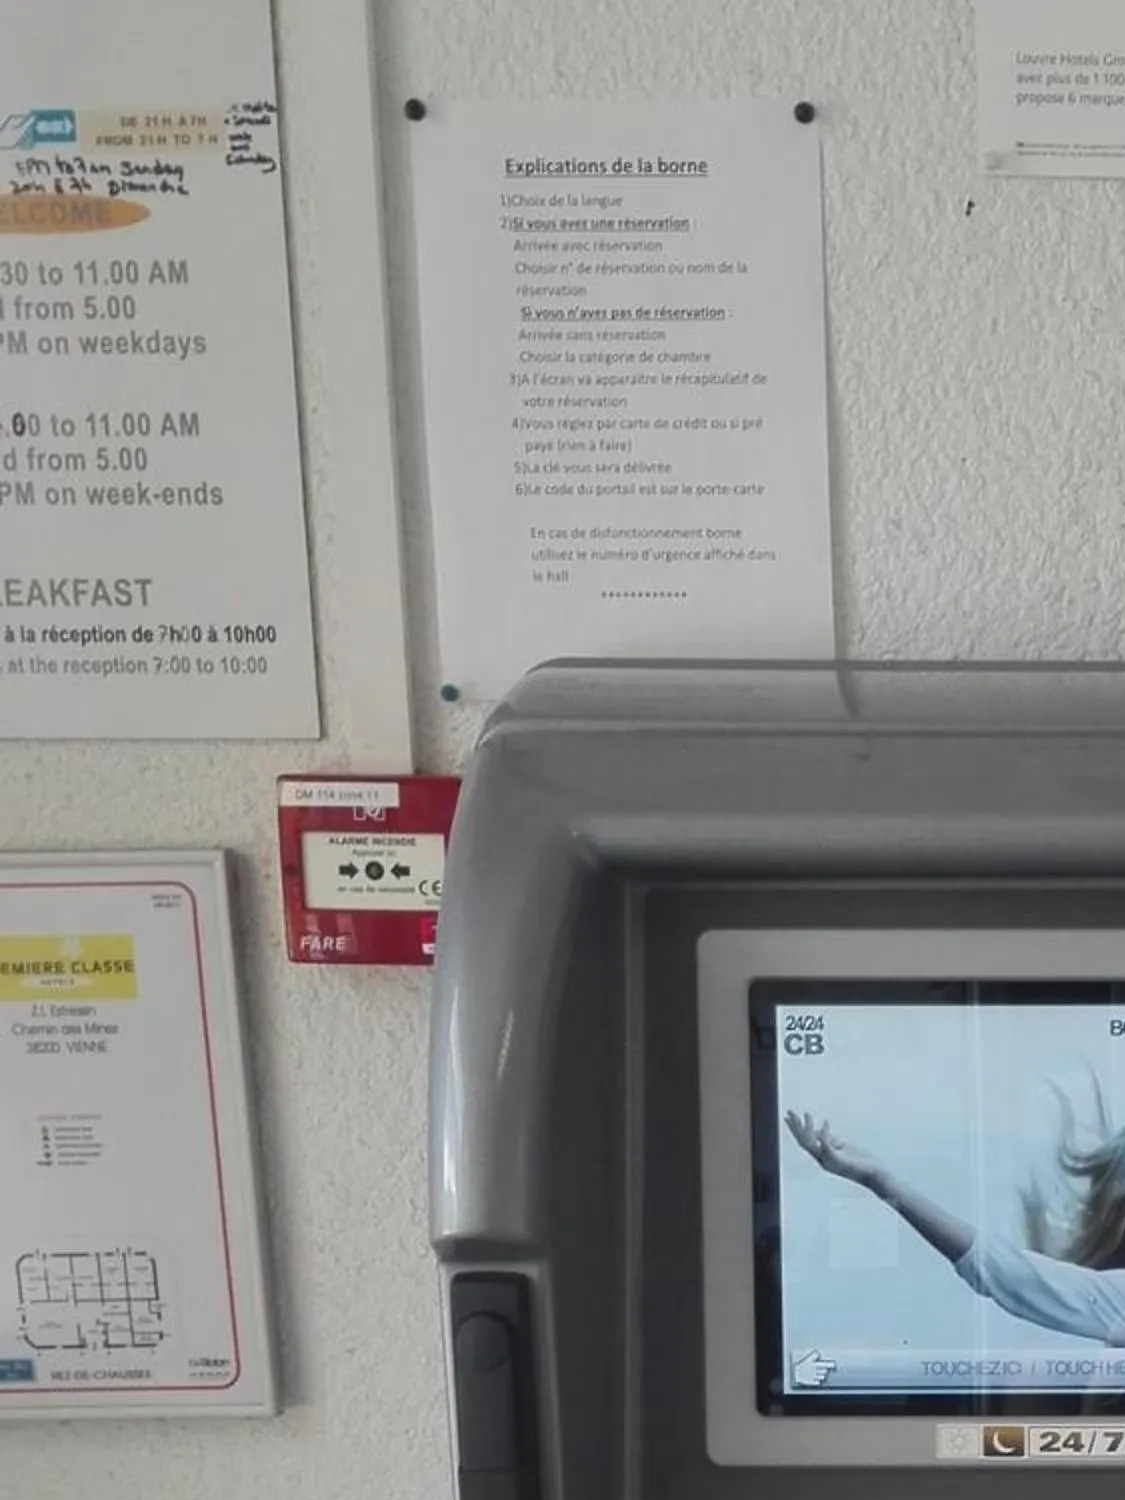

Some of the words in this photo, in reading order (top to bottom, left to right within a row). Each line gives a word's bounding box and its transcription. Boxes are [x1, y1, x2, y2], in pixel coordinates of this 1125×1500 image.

[1075, 73, 1089, 85] de
[505, 156, 606, 177] Explications
[612, 156, 633, 173] de
[638, 157, 653, 173] la
[658, 156, 708, 173] borne
[549, 194, 565, 206] de
[568, 194, 578, 206] la
[581, 194, 623, 209] langue
[527, 219, 556, 230] vous
[592, 219, 614, 230] une
[618, 215, 689, 231] réservation
[562, 242, 590, 251] avec
[593, 240, 663, 252] réservation
[38, 262, 63, 285] to
[73, 260, 139, 285] 11.00
[149, 260, 189, 285] AM
[515, 262, 557, 274] Choisir
[577, 262, 591, 274] de
[596, 260, 665, 275] réservation
[668, 263, 684, 274] ou
[687, 263, 715, 273] nom
[718, 262, 733, 273] de
[737, 261, 748, 273] la
[516, 285, 587, 297] réservation
[14, 295, 74, 320] from
[84, 296, 136, 320] 5.00
[535, 308, 565, 319] vous
[611, 308, 633, 320] pas
[636, 306, 651, 319] de
[654, 305, 725, 319] réservation
[597, 328, 667, 341] réservation
[37, 337, 69, 355] on
[78, 330, 207, 360] weekdays
[519, 351, 562, 363] Choisir
[566, 351, 576, 362] la
[579, 351, 635, 366] catégorie
[639, 351, 653, 363] de
[657, 351, 711, 364] chambre
[752, 373, 767, 385] de
[523, 397, 555, 408] votre
[557, 395, 628, 408] réservation
[50, 413, 76, 437] to
[85, 412, 151, 437] 11.00
[160, 412, 200, 437] AM
[597, 419, 615, 431] par
[619, 419, 650, 430] carte
[654, 418, 669, 430] de
[672, 417, 707, 430] crédit
[711, 420, 727, 430] ou
[27, 447, 86, 471] from
[96, 447, 148, 471] 5.00
[563, 463, 593, 474] vous
[45, 486, 76, 506] on
[85, 482, 224, 506] week-ends
[544, 483, 574, 496] code
[577, 483, 593, 495] du
[596, 483, 636, 497] portail
[681, 483, 693, 495] le
[530, 527, 546, 540] En
[549, 529, 568, 540] cas
[571, 527, 586, 540] de
[705, 527, 742, 540] borne
[577, 549, 588, 561] le
[591, 548, 638, 561] numéro
[748, 549, 776, 561] dans
[532, 569, 544, 582] le
[547, 569, 569, 582] hall
[0, 578, 153, 607] EAKFAST
[4, 625, 15, 643] à
[20, 625, 35, 643] la
[41, 625, 127, 648] réception
[131, 625, 154, 643] de
[207, 625, 218, 643] à
[223, 625, 277, 643] 10h00
[8, 657, 25, 674] at
[29, 655, 57, 674] the
[63, 655, 148, 678] reception
[196, 655, 214, 674] to
[221, 656, 268, 675] 10:00
[301, 934, 348, 952] FARE
[70, 959, 136, 975] CLASSE
[783, 1033, 825, 1055] CB
[921, 1359, 1000, 1377] TOUCHEZ
[1046, 1359, 1101, 1376] TOUCH
